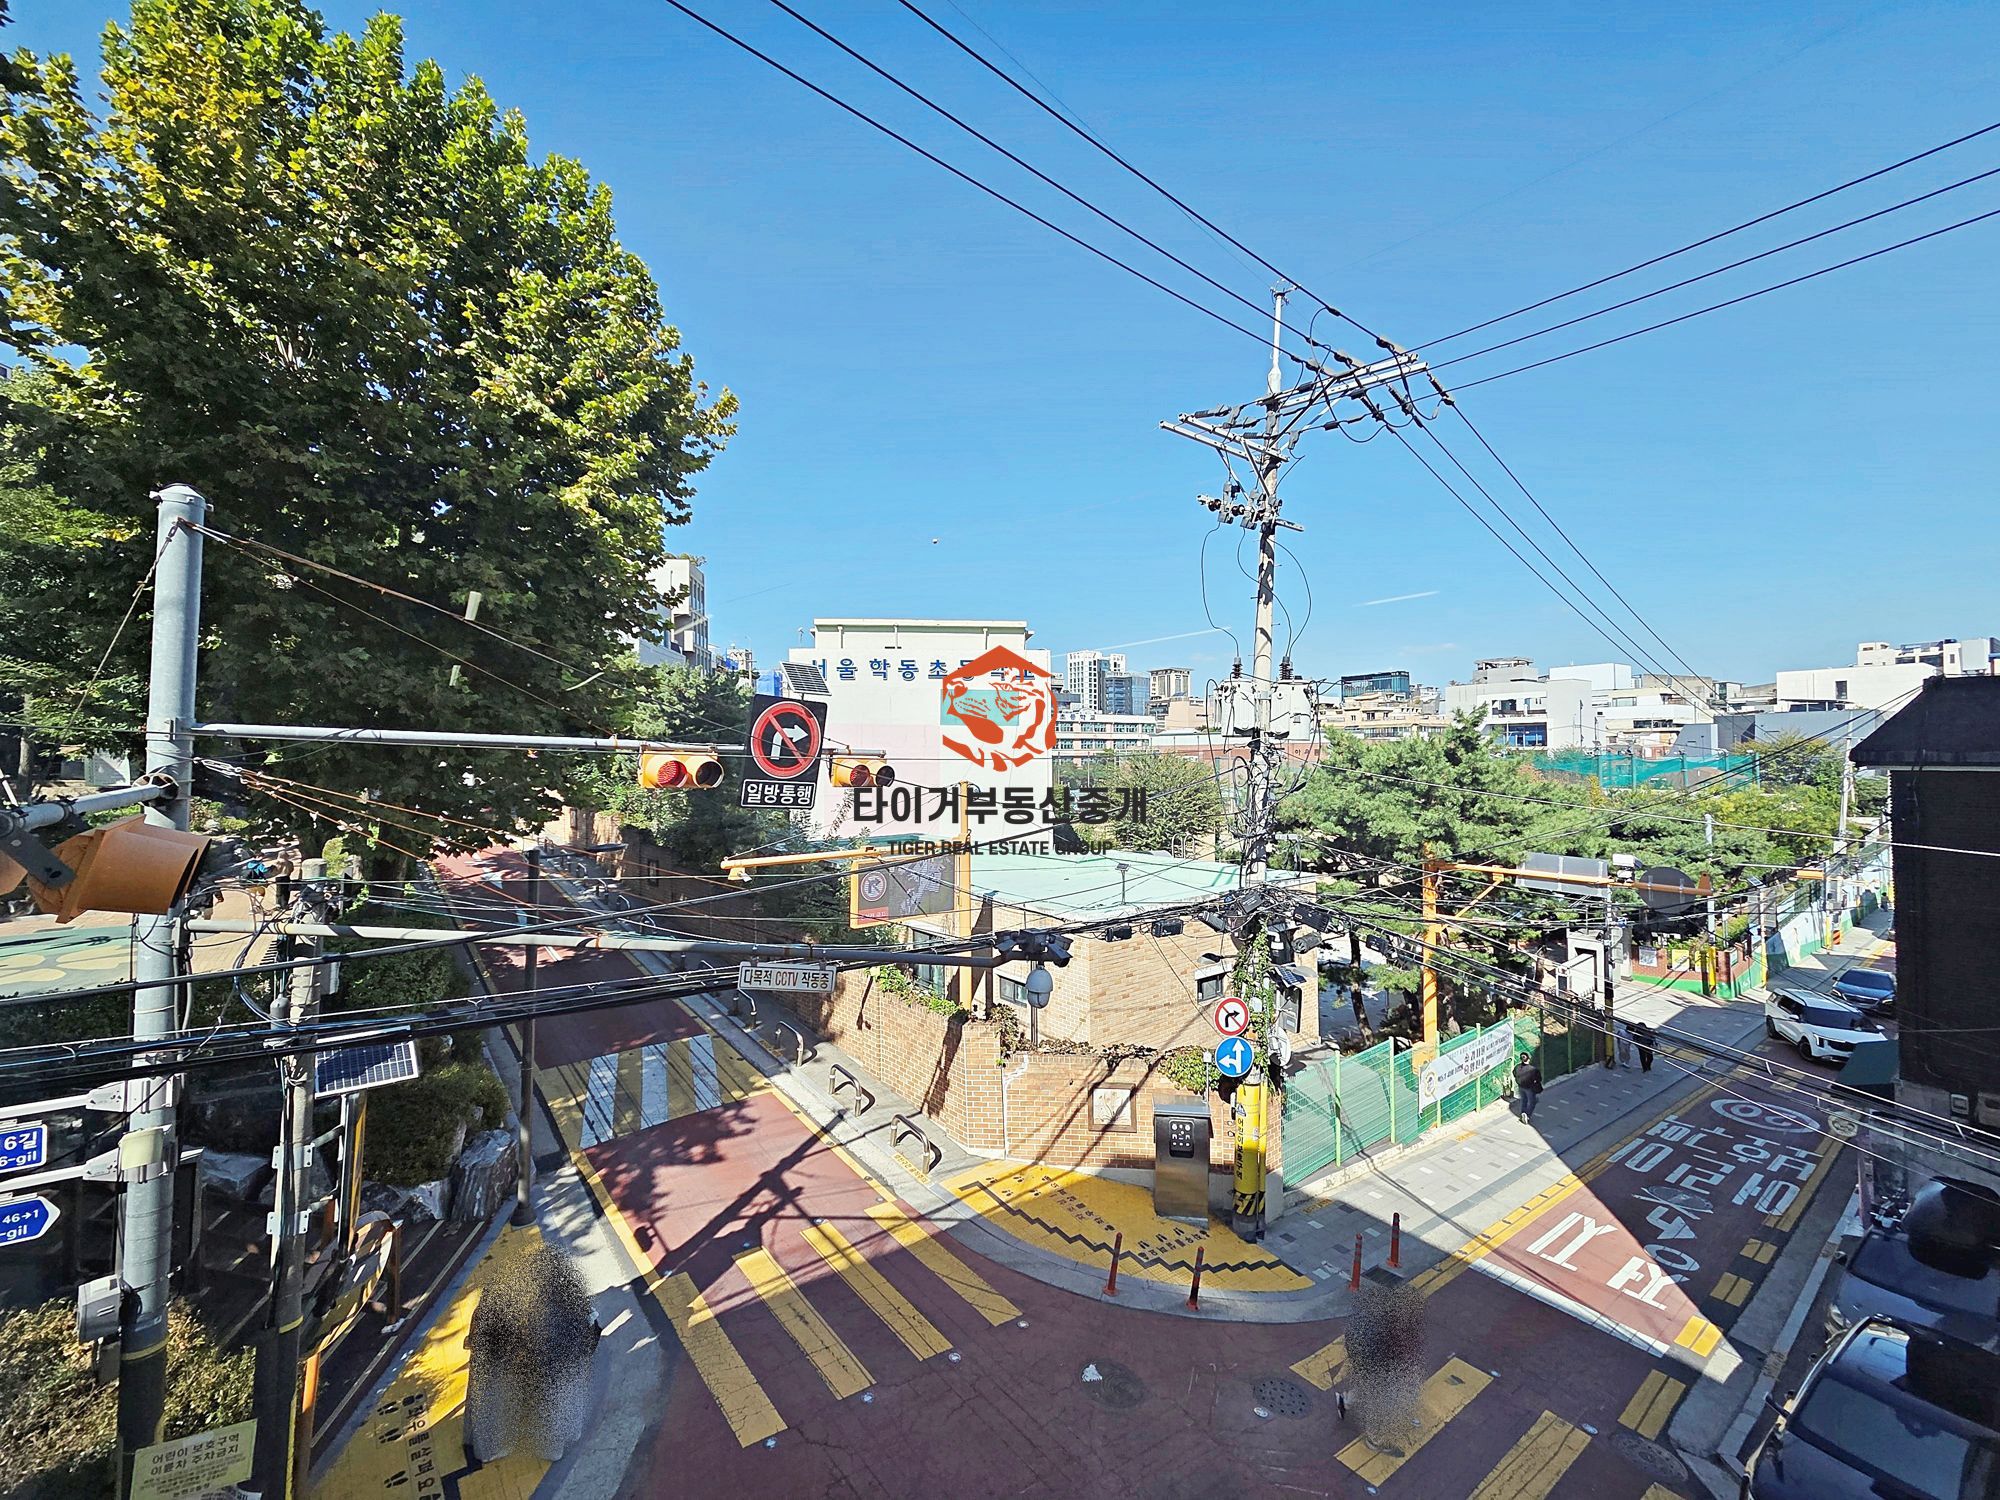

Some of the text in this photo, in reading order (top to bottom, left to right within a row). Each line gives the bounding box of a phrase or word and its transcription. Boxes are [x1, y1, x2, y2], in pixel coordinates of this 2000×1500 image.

[747, 783, 812, 806] 일방통행
[743, 969, 829, 989] 다목적 CCTV 작동중
[1645, 1115, 1823, 1181] 보호구역
[1607, 1137, 1801, 1216] 어린이
[150, 1460, 187, 1476] 이륜차
[191, 1444, 239, 1464] 주차금지
[151, 1433, 240, 1465] 어린이 보호구역
